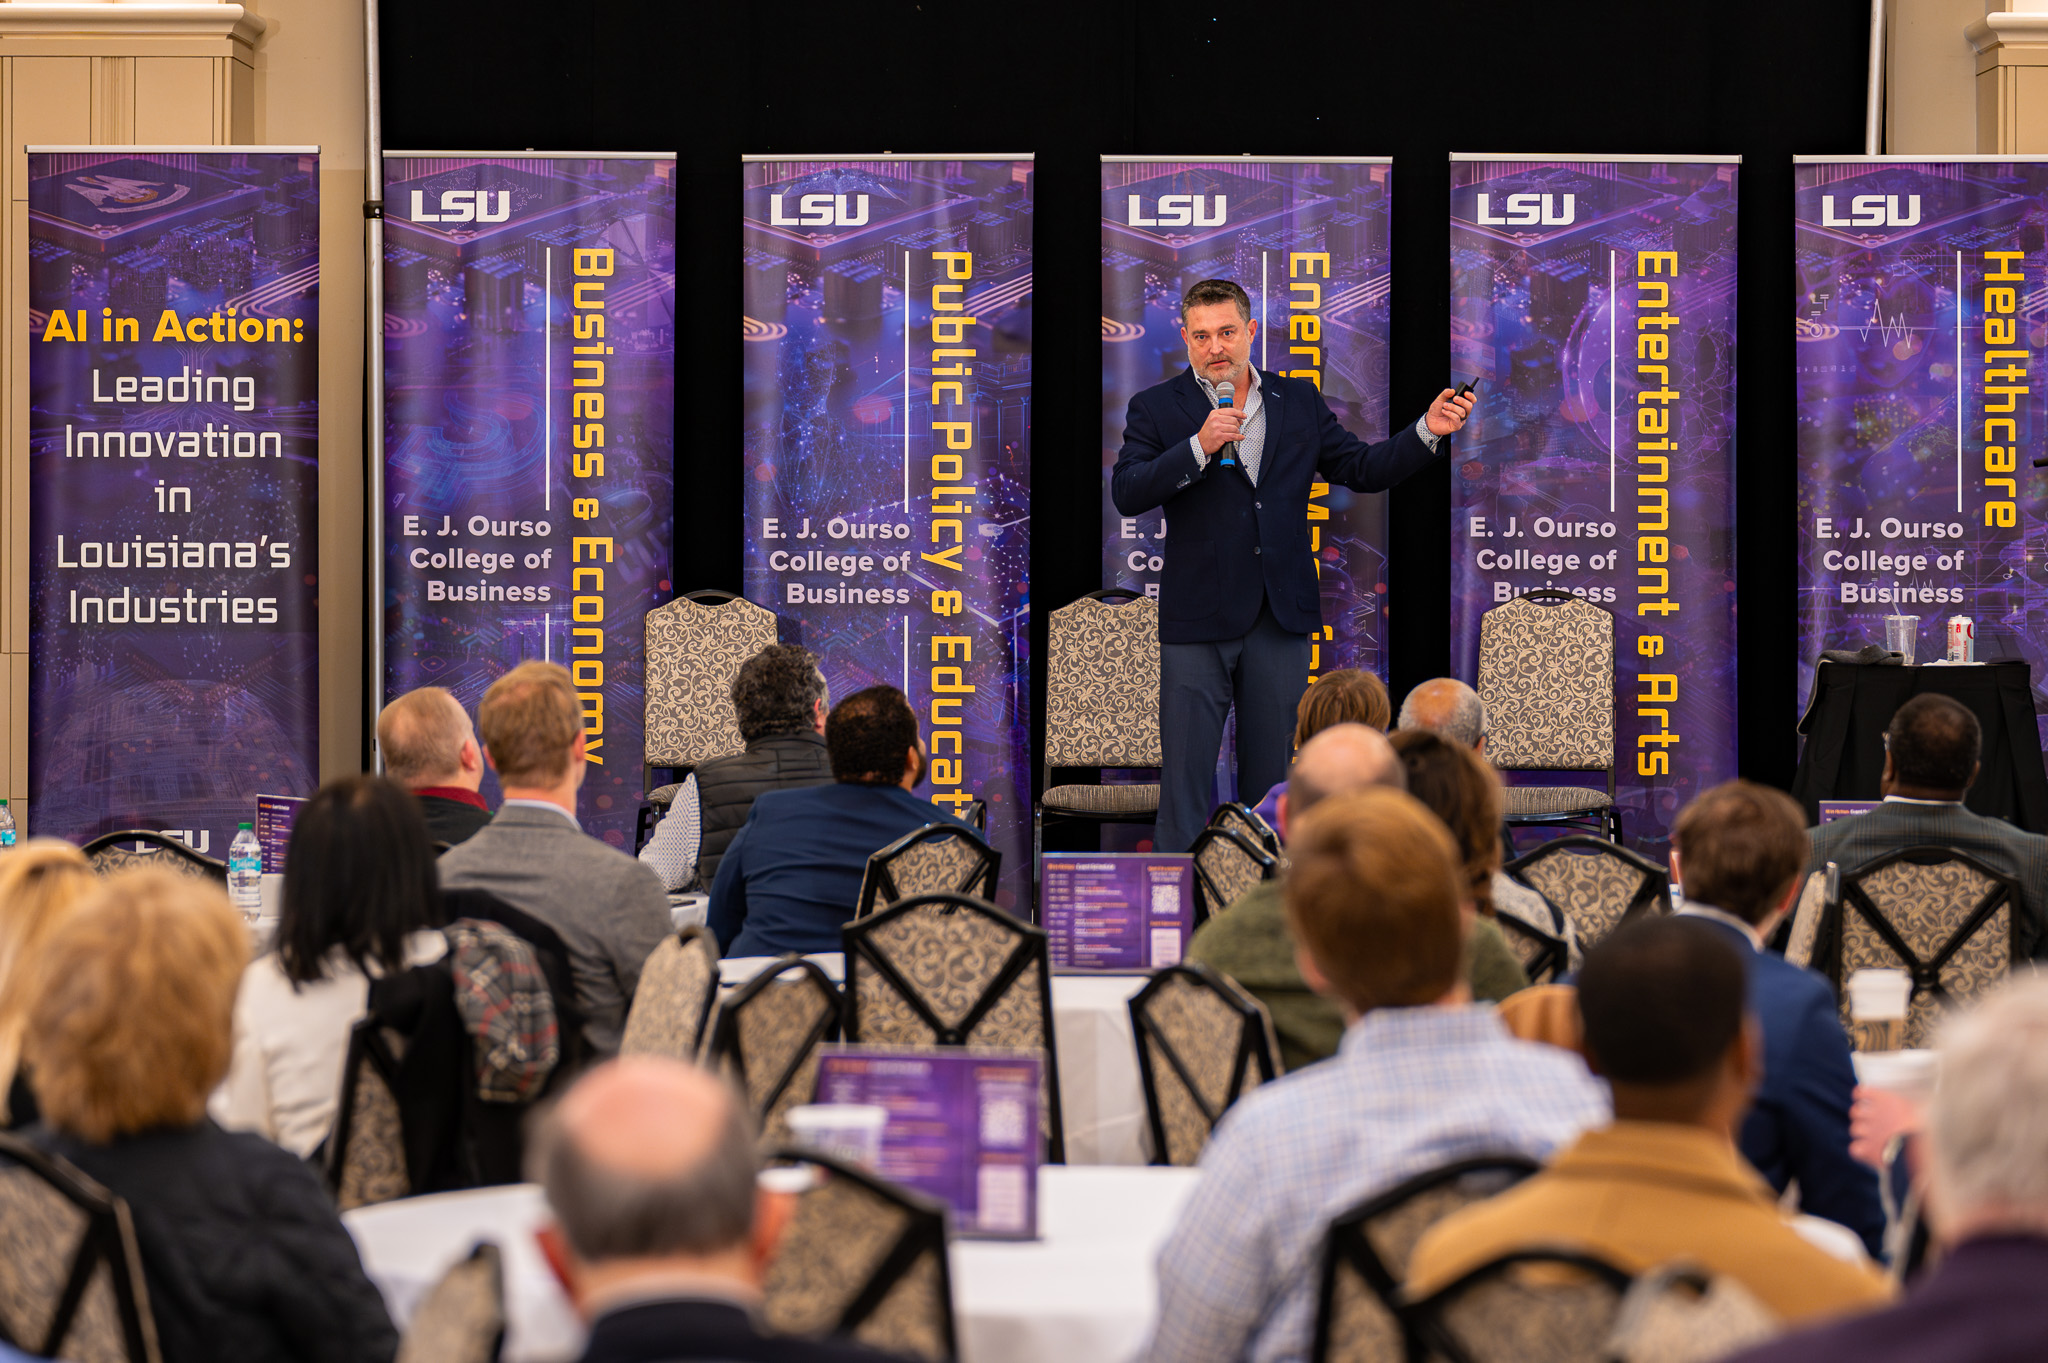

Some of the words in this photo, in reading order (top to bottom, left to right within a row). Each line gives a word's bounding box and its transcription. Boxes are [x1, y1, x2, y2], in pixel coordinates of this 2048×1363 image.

[410, 189, 511, 223] LSU
[770, 194, 869, 227] LSU
[1128, 194, 1227, 227] LSU
[1476, 193, 1575, 226] LSU
[1822, 194, 1921, 227] LSU
[42, 309, 87, 343] AI
[102, 308, 139, 343] in
[152, 308, 304, 343] Action:
[931, 251, 977, 405] Public
[572, 247, 614, 478] Business
[93, 366, 255, 411] Leading
[1984, 251, 2030, 528] Healthcare
[65, 423, 282, 458] Innovation
[1637, 250, 1680, 616] Entertainment
[154, 480, 191, 513] in
[572, 498, 604, 521] &
[920, 421, 977, 571] Policy
[403, 515, 428, 537] E.
[436, 515, 459, 537] J.
[467, 515, 551, 537] Ourso
[762, 518, 787, 539] E.
[796, 518, 818, 539] J.
[827, 518, 910, 540] Ourso
[1121, 518, 1145, 539] E.
[1153, 518, 1167, 539] J
[1470, 516, 1494, 538] E.
[1502, 516, 1524, 538] J.
[1533, 516, 1617, 538] Ourso
[1816, 517, 1841, 539] E.
[1849, 517, 1871, 539] J.
[1880, 517, 1964, 540] Ourso
[57, 535, 291, 568] Louisiana’s
[409, 547, 515, 574] College
[524, 548, 552, 569] of
[769, 550, 874, 577] College
[881, 551, 910, 572] of
[1476, 548, 1581, 576] College
[1589, 549, 1617, 570] of
[1822, 550, 1928, 577] College
[1936, 551, 1964, 571] of
[70, 586, 278, 624] Industries
[427, 579, 551, 602] Business
[786, 581, 910, 604] Business
[931, 590, 963, 617] &
[1840, 582, 1964, 604] Business
[1637, 635, 1664, 658] &
[931, 635, 976, 817] Educat
[1637, 673, 1680, 776] Arts
